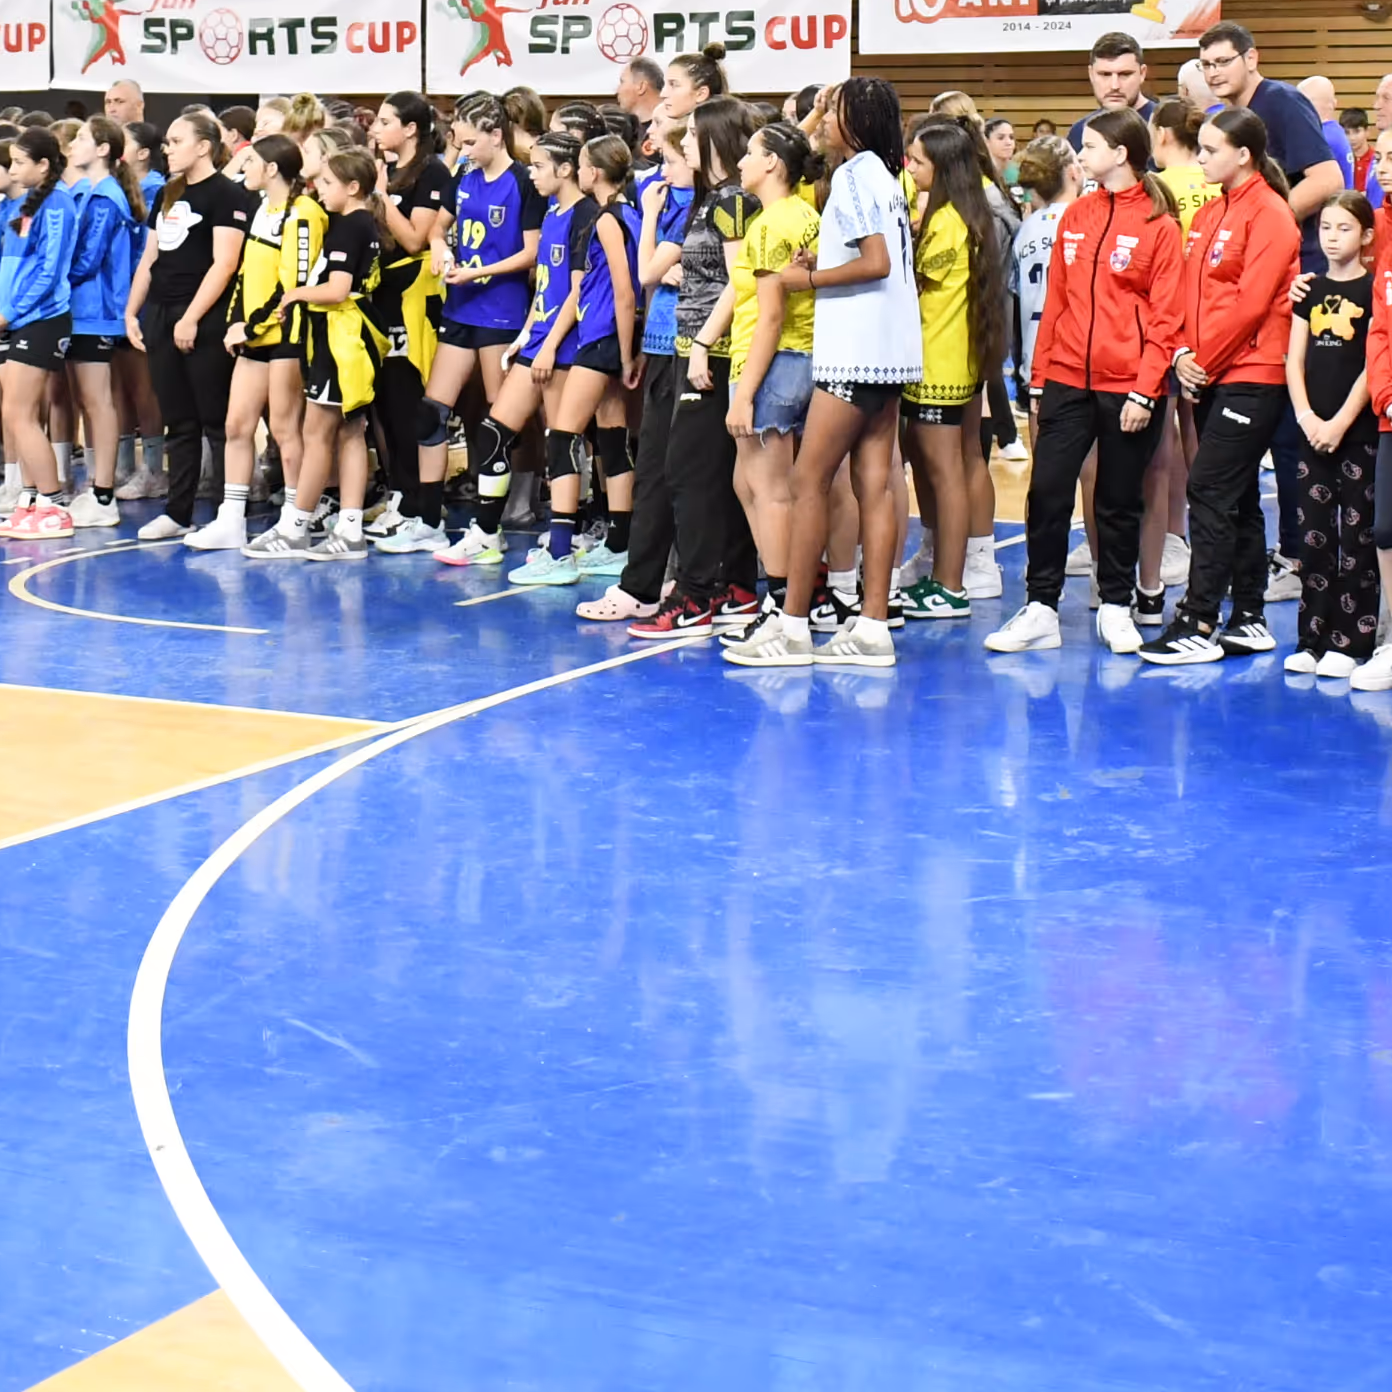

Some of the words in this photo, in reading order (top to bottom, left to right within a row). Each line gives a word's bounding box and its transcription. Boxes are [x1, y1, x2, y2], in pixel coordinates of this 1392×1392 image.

[345, 21, 417, 54] CUP
[764, 15, 847, 50] CUP
[1002, 21, 1031, 32] 2014
[1043, 20, 1072, 31] 2024
[462, 219, 486, 249] 19
